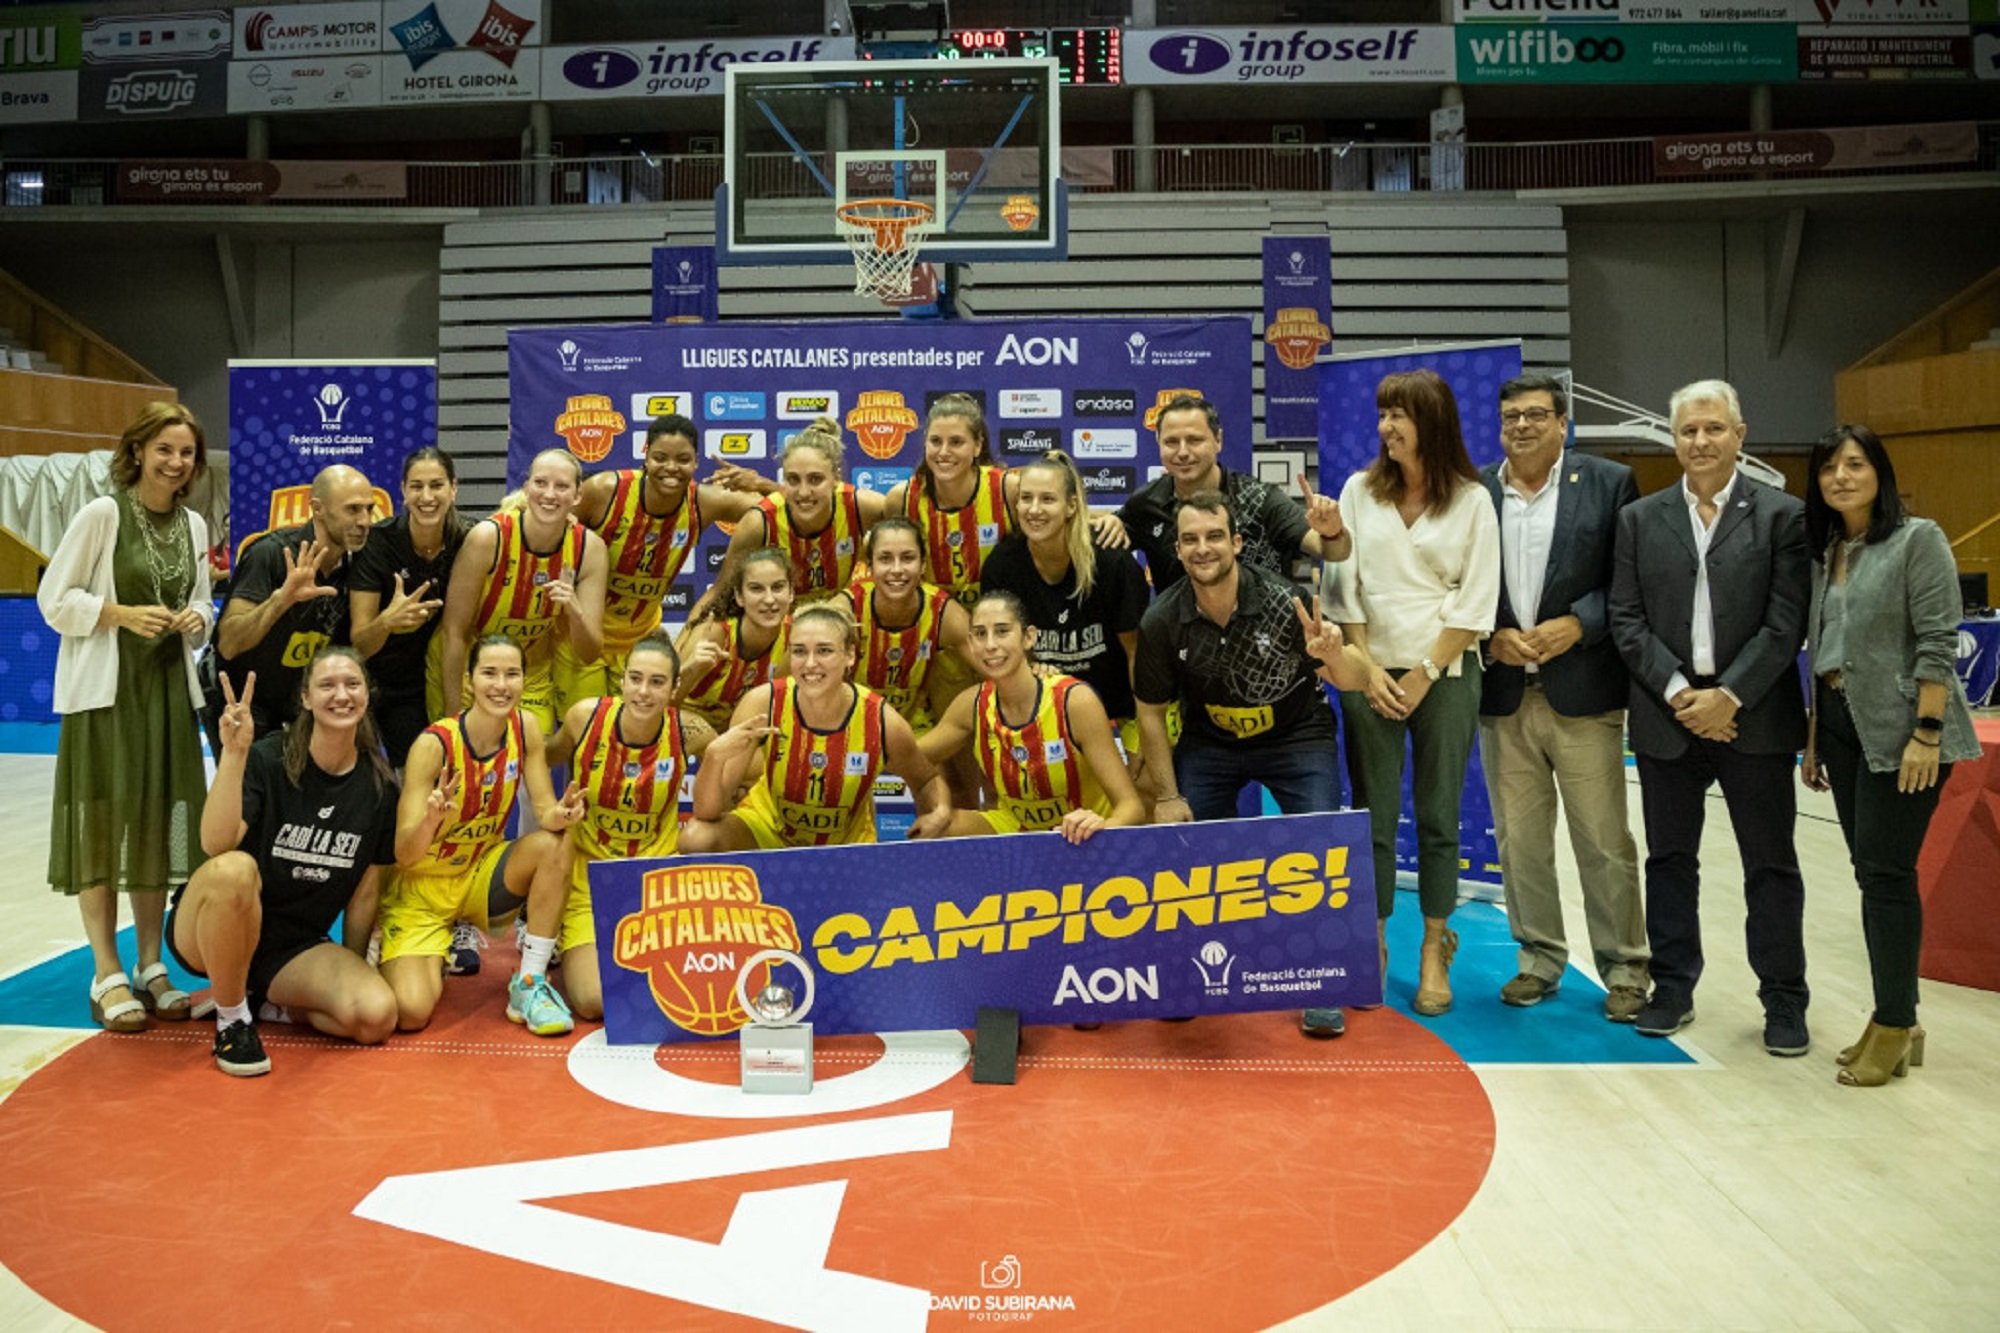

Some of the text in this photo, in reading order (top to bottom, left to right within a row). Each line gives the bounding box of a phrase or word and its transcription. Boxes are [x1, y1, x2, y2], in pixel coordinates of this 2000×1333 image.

[267, 22, 377, 39] CAMPS MOTOR
[403, 18, 435, 44] ibis
[481, 16, 520, 47] ibis
[1239, 29, 1418, 62] infoself
[1469, 29, 1624, 64] wifiboo
[1810, 38, 1868, 52] REPARACIÓ
[1810, 54, 1824, 65] DE
[1894, 53, 1955, 65] INDUSTRIAL
[404, 74, 518, 90] HOTEL GIRONA
[1238, 63, 1305, 81] group
[105, 79, 196, 104] DISPUIG
[646, 76, 710, 95] group
[1665, 139, 1774, 161] girona ets tu
[1702, 154, 1747, 170] girona
[1769, 151, 1814, 167] esport
[129, 167, 230, 184] girona ets tu
[162, 181, 202, 194] girona
[223, 180, 264, 193] esport
[681, 333, 1079, 370] LLIGUES CATALANES presentades per AON
[1075, 396, 1134, 411] endesa
[558, 412, 625, 431] CATALANES
[849, 407, 915, 426] CATALANES
[289, 434, 374, 445] Federació Catalana
[579, 428, 602, 438] AON
[870, 424, 894, 434] AON
[299, 446, 312, 456] de
[1007, 437, 1052, 449] SPALDING
[952, 551, 964, 578] 5
[1062, 629, 1078, 653] LA
[1081, 622, 1104, 649] SEU
[1213, 709, 1266, 733] CADÍ
[622, 782, 632, 807] 4
[808, 773, 825, 802] 11
[782, 807, 840, 829] CADÍ
[1011, 800, 1064, 823] CADÍ
[597, 814, 650, 834] CADÍ
[274, 823, 315, 851] CADÍ
[311, 828, 333, 854] LA
[330, 831, 362, 858] SEU
[647, 868, 754, 909] LLIGUES
[812, 846, 1352, 974] CAMPIONES!
[620, 904, 797, 961] CATALANES
[682, 950, 735, 975] AON
[1052, 965, 1160, 1006] AON
[1241, 967, 1347, 983] Federació Catalana
[1243, 980, 1323, 994] de Basquetbol
